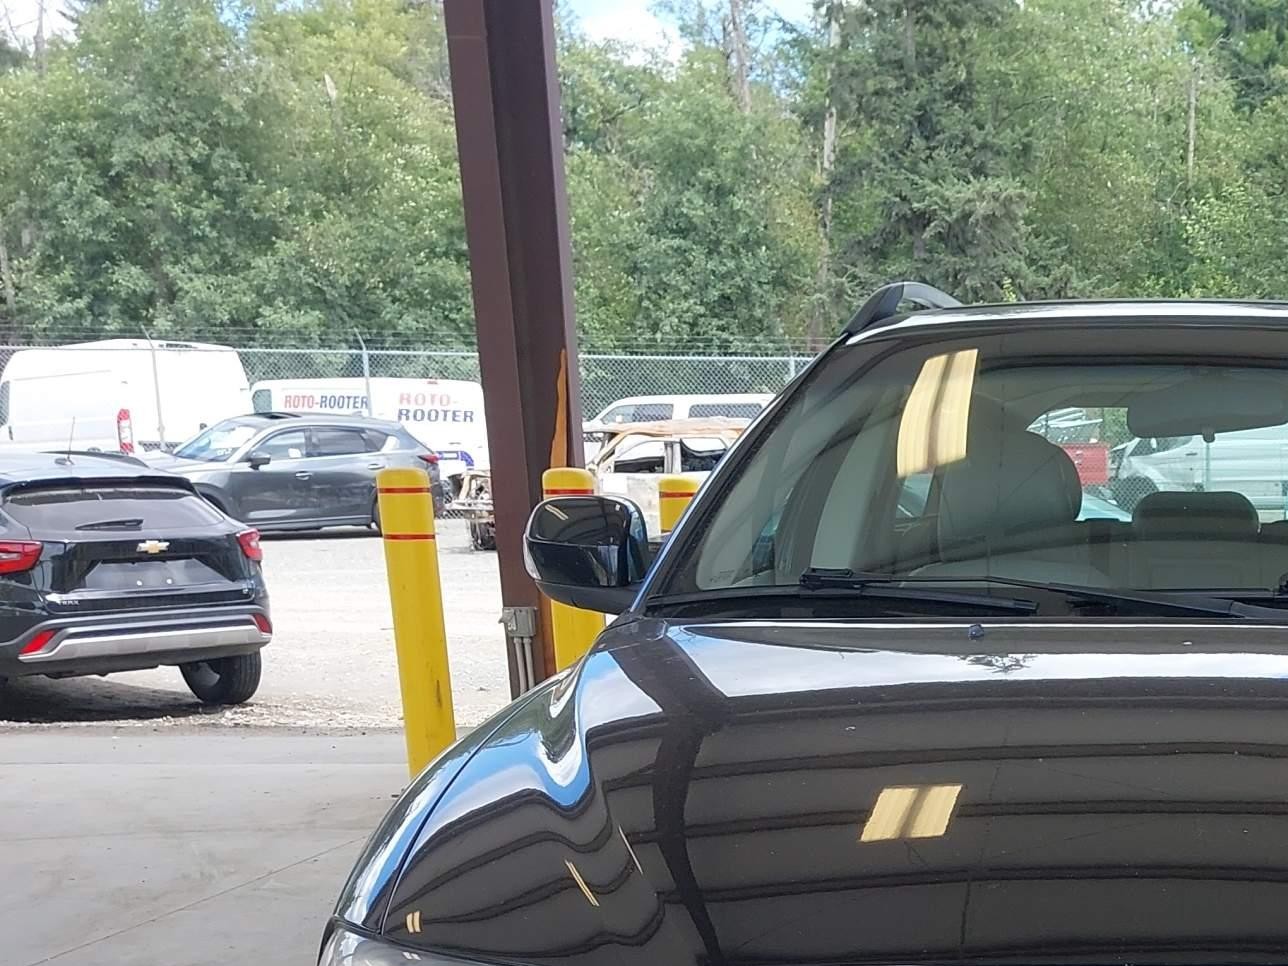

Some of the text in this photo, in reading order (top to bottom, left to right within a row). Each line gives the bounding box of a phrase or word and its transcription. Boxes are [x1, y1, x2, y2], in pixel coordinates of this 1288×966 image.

[284, 395, 368, 409] ROTO-ROOTER
[399, 392, 457, 407] ROTO-
[398, 408, 474, 422] ROOTER
